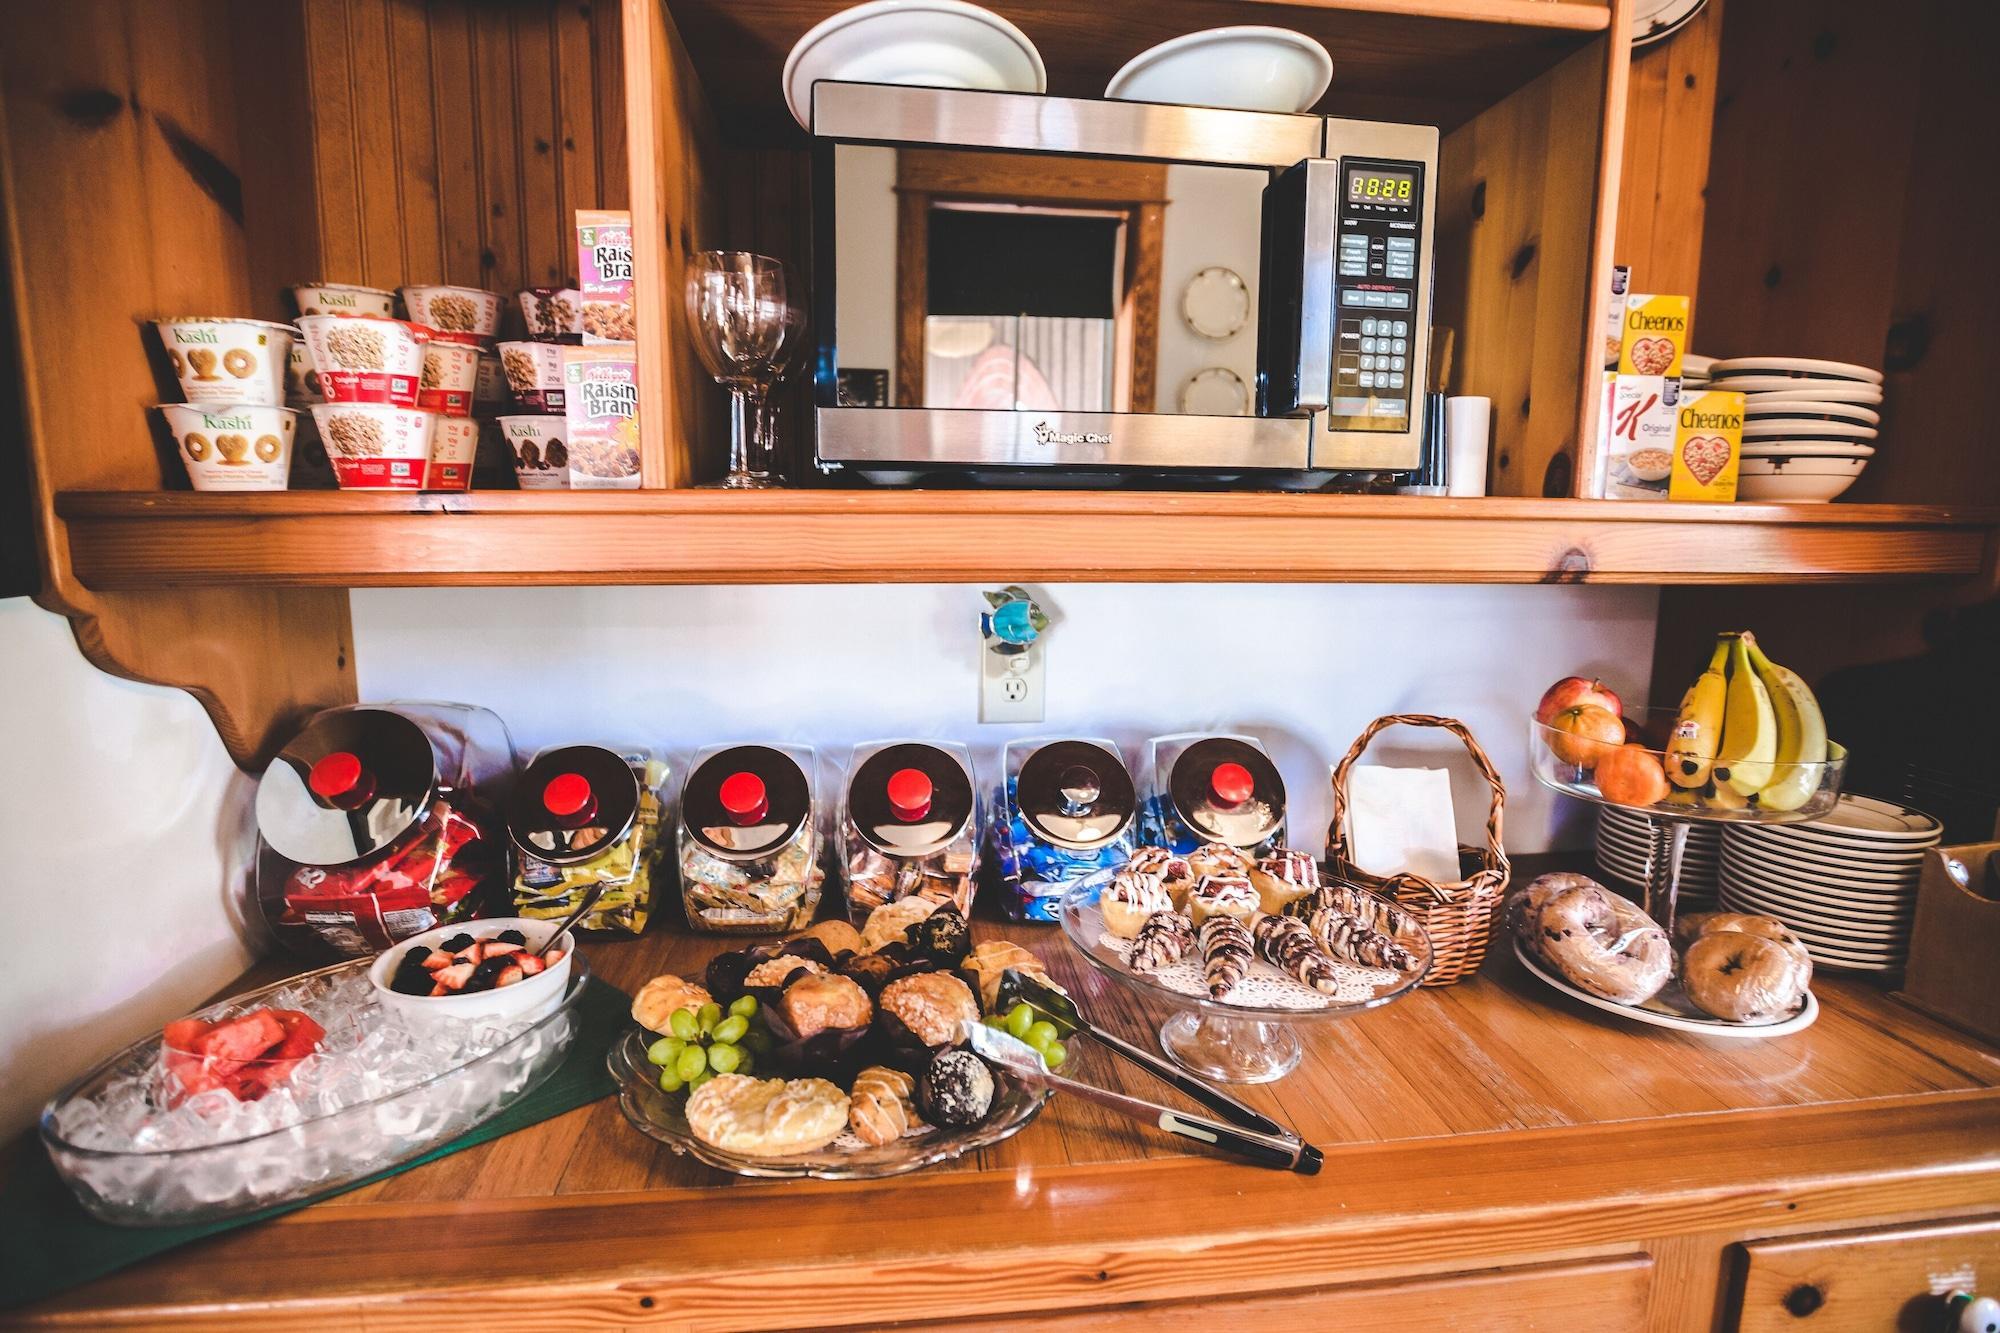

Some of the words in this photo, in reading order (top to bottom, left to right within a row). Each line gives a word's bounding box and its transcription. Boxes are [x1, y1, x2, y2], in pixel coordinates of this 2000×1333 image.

[596, 247, 632, 263] Rais
[603, 263, 632, 278] Bra
[319, 292, 356, 307] Kashi
[1629, 310, 1684, 331] Cheerios
[173, 328, 219, 344] Kashi
[1367, 323, 1372, 333] 1
[1381, 324, 1388, 333] 2
[1396, 325, 1403, 334] 3
[1364, 341, 1372, 350] 4
[1380, 341, 1387, 351] 5
[1395, 342, 1402, 352] 6
[1364, 358, 1371, 367] 7
[1380, 359, 1386, 368] 8
[1394, 359, 1401, 369] 9
[1378, 375, 1385, 385] 0
[584, 383, 636, 401] Raisin
[590, 400, 632, 416] Bran
[203, 414, 252, 430] Kashi
[1615, 393, 1657, 440] K
[1681, 408, 1740, 429] Cheerios
[510, 424, 541, 437] Kashi
[1642, 424, 1671, 433] Original
[1050, 432, 1085, 444] Magic
[1085, 433, 1112, 444] Chef
